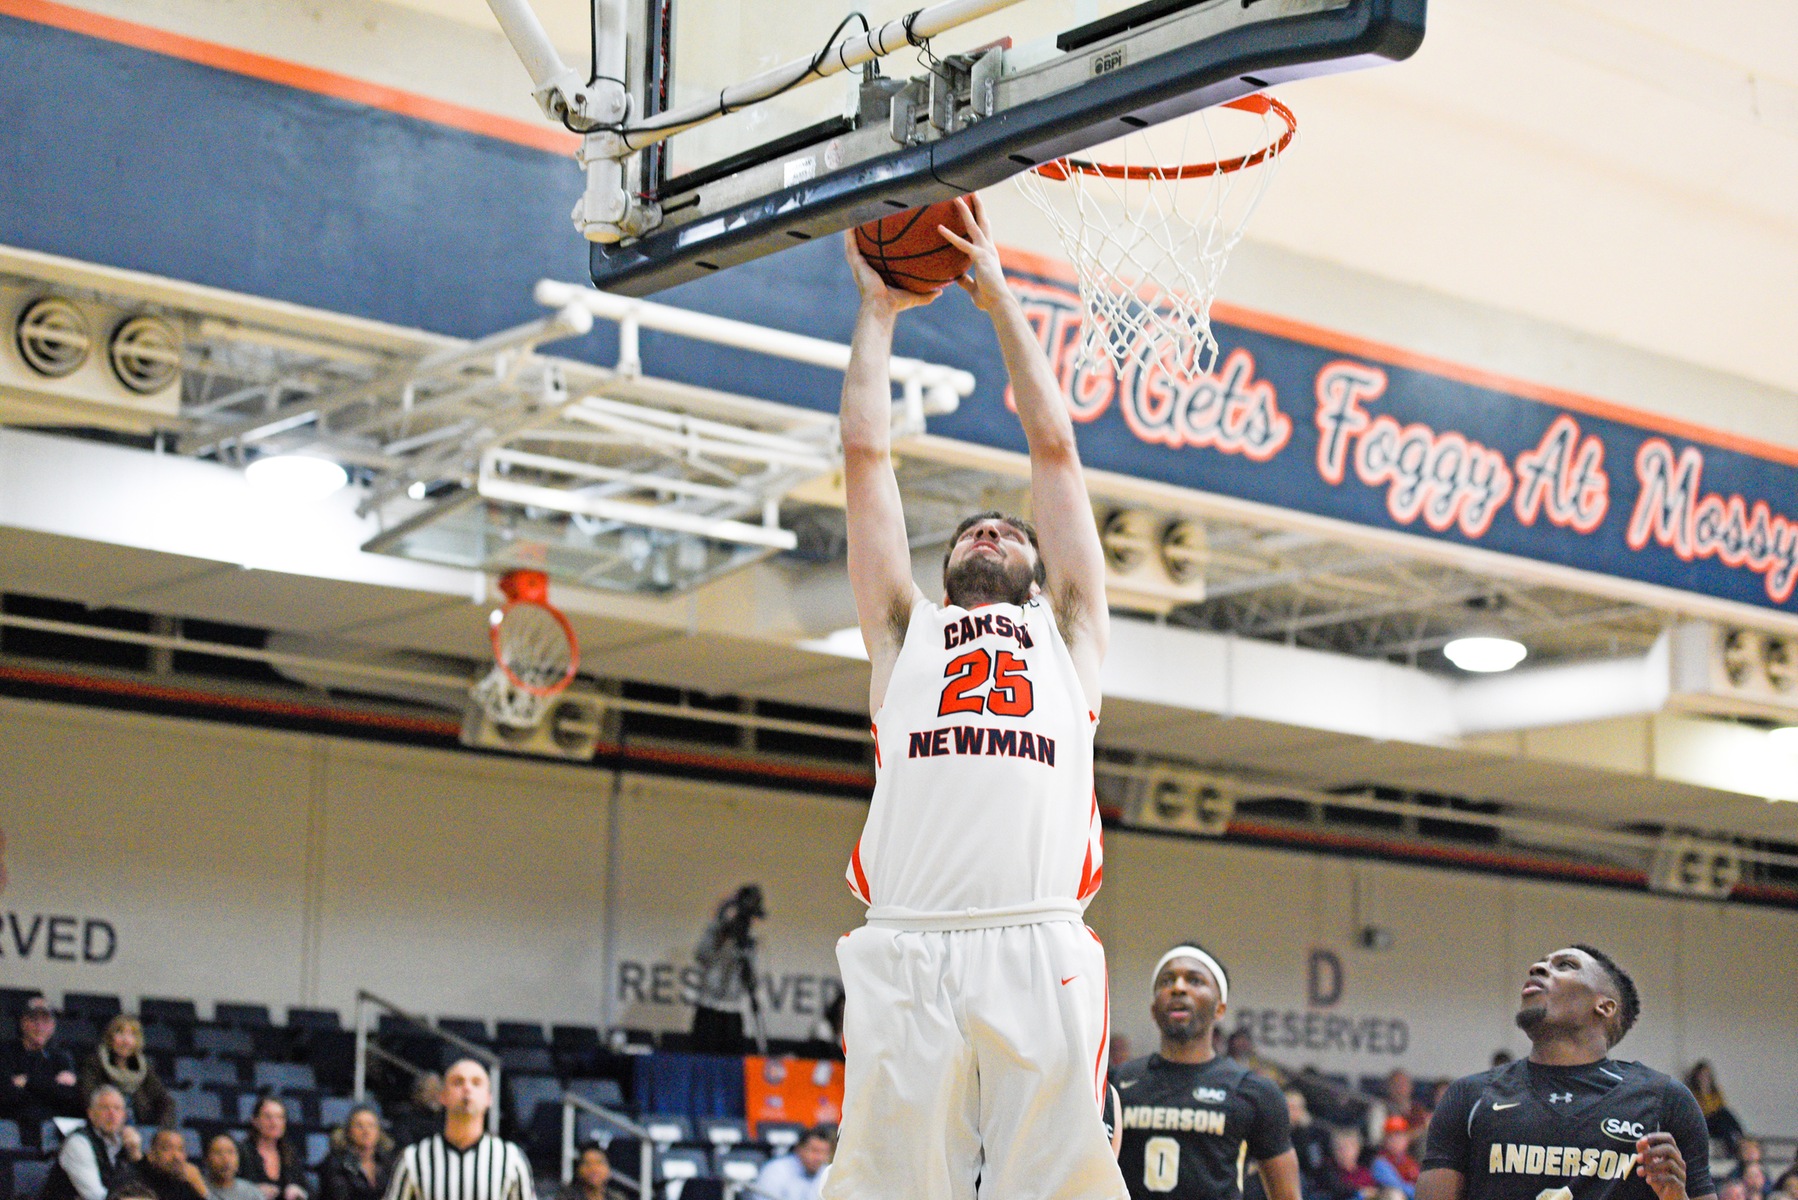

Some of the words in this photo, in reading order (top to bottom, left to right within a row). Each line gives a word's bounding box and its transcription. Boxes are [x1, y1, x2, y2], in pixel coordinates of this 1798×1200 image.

[1120, 315, 1293, 461] Gets
[1315, 360, 1514, 538] Foggy
[1514, 413, 1610, 535] At
[1626, 437, 1798, 603] Mossy
[937, 647, 1034, 718] 25
[908, 725, 1055, 768] NEWMAN
[0, 912, 117, 963] VED
[1307, 950, 1344, 1007] D
[1122, 1105, 1226, 1136] NDERSON
[1606, 1118, 1645, 1139] SAC
[1143, 1136, 1180, 1192] 0
[1489, 1143, 1638, 1181] ANDERSON
